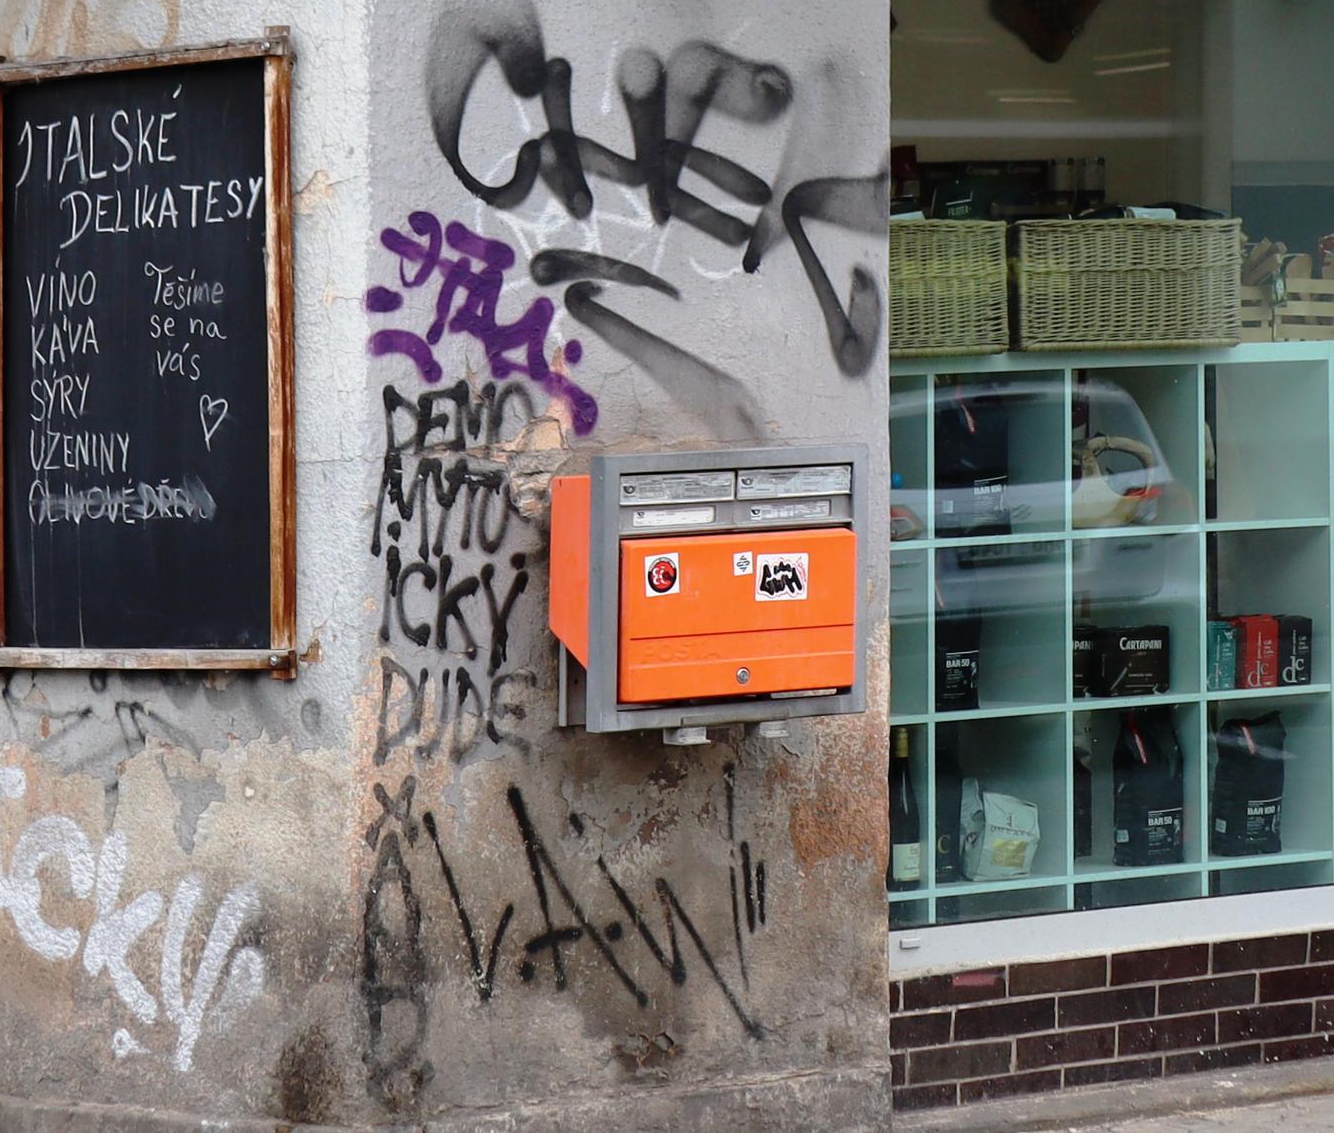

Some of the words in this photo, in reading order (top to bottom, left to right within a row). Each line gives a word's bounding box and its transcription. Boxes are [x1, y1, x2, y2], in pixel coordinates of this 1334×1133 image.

[16, 83, 183, 188] ITALSKÉ
[59, 175, 264, 250] DELIKATESY
[26, 255, 97, 318] VÍNO
[30, 314, 100, 368] KÁVA
[150, 314, 175, 339] se
[189, 316, 228, 340] na
[155, 343, 201, 381] vás
[30, 370, 90, 422] SÝRY
[30, 430, 130, 476] UZENINY
[1148, 817, 1164, 826] BAR
[1247, 806, 1264, 816] BAR
